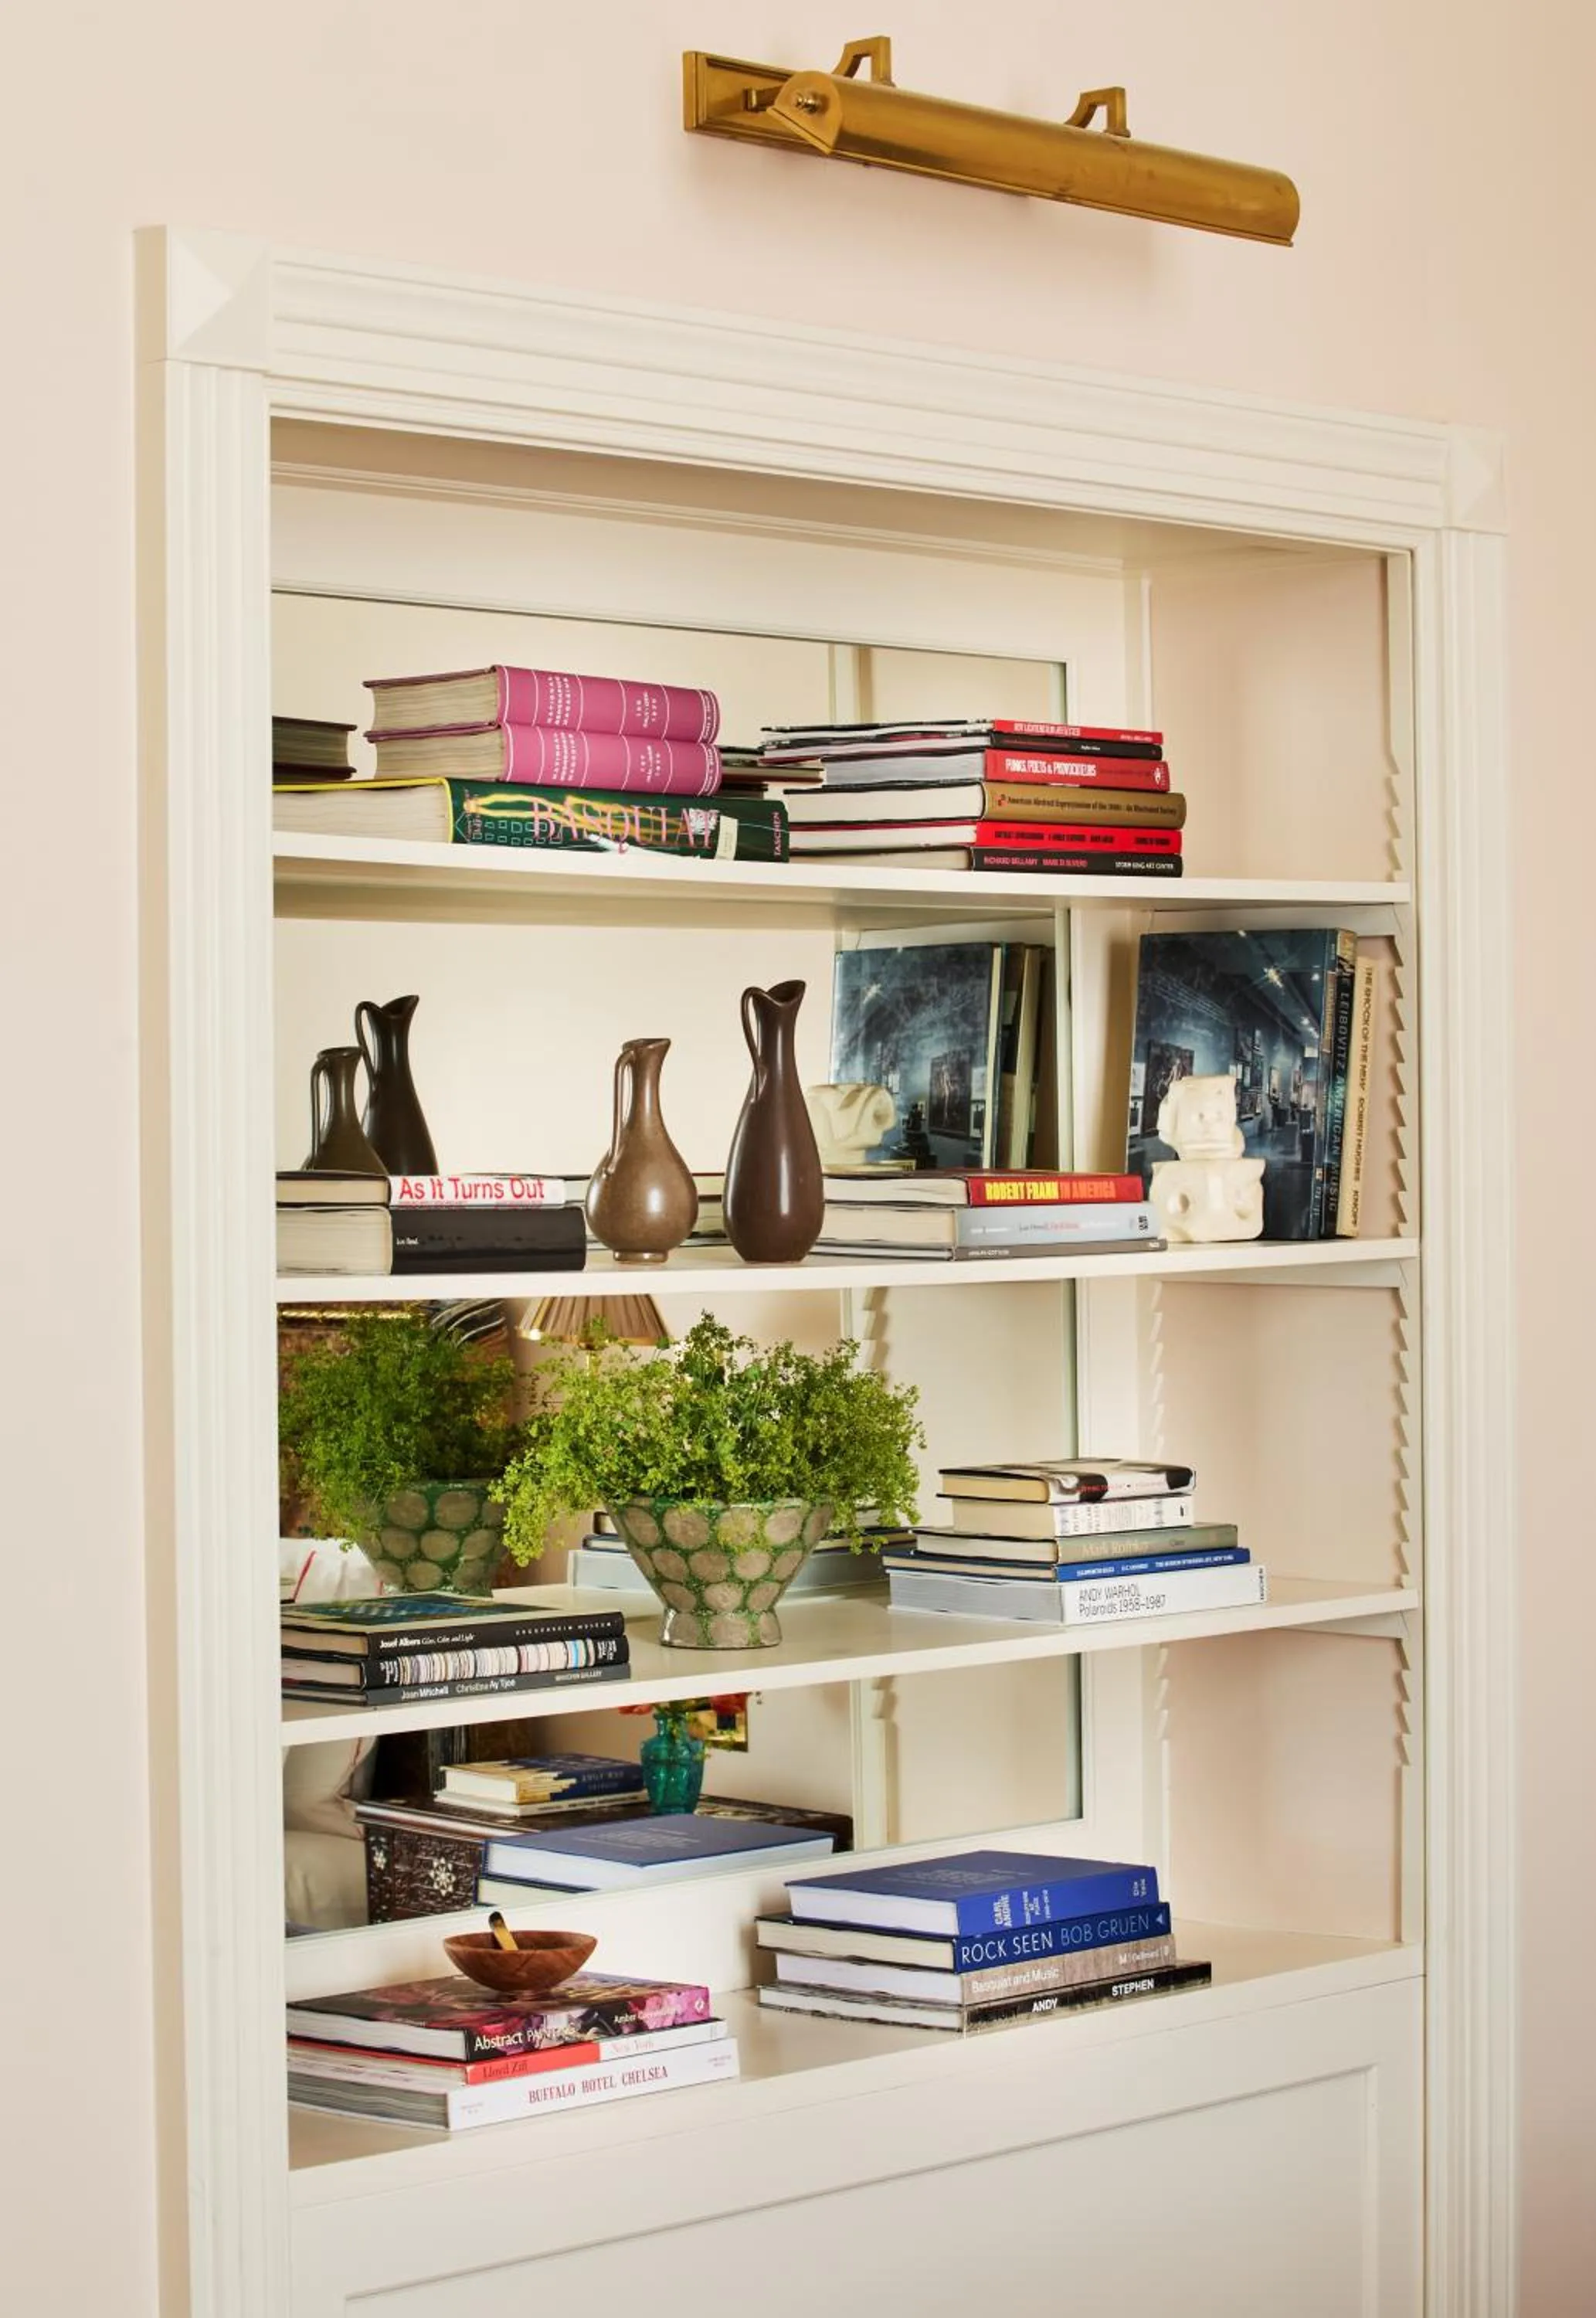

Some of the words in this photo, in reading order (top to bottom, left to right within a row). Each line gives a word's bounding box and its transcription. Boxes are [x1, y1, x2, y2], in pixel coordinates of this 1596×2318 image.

[532, 797, 720, 853] BASQUIAT
[1362, 987, 1371, 1026] SHOCK
[1337, 992, 1350, 1071] LEIBOVITZ
[1362, 1027, 1370, 1042] OF
[1333, 1075, 1345, 1155] AMERICAN
[399, 1178, 426, 1200] As
[430, 1178, 444, 1198] It
[448, 1178, 504, 1198] Turns
[511, 1177, 545, 1198] Out
[986, 1181, 1025, 1201] ROBERT
[1027, 1181, 1058, 1200] FRANK
[1060, 1181, 1071, 1199] IN
[1072, 1180, 1116, 1199] AMERICA
[1329, 1161, 1340, 1212] MUSIC
[1079, 1588, 1102, 1603] ANDY
[1105, 1584, 1141, 1599] WARHOL
[1079, 1598, 1118, 1617] Polaroids
[379, 1637, 397, 1649] Josef
[399, 1637, 421, 1647] Albers
[402, 1689, 419, 1699] Joan
[419, 1685, 449, 1698] Mitchell
[456, 1682, 488, 1694] Christine
[490, 1680, 499, 1690] Ay
[993, 1901, 1003, 1925] CARL
[1001, 1894, 1012, 1927] ANDRE
[962, 1939, 1007, 1963] ROCK
[1013, 1931, 1053, 1956] SEEN
[1061, 1923, 1093, 1946] BOB
[1098, 1912, 1149, 1939] GRUEN
[972, 1975, 1012, 1993] Basquiat
[1013, 1973, 1031, 1987] and
[1032, 1966, 1059, 1983] Music
[1111, 1978, 1155, 1997] STEPHEN
[1032, 1997, 1058, 2013] ANDY
[614, 2013, 636, 2024] Amber
[474, 2031, 523, 2051] Abstract
[482, 2065, 510, 2080] Lloyd
[511, 2060, 528, 2075] Ziff
[528, 2082, 576, 2104] BUFFALO
[582, 2075, 617, 2094] HOTEL
[621, 2065, 669, 2086] CHELSEA
